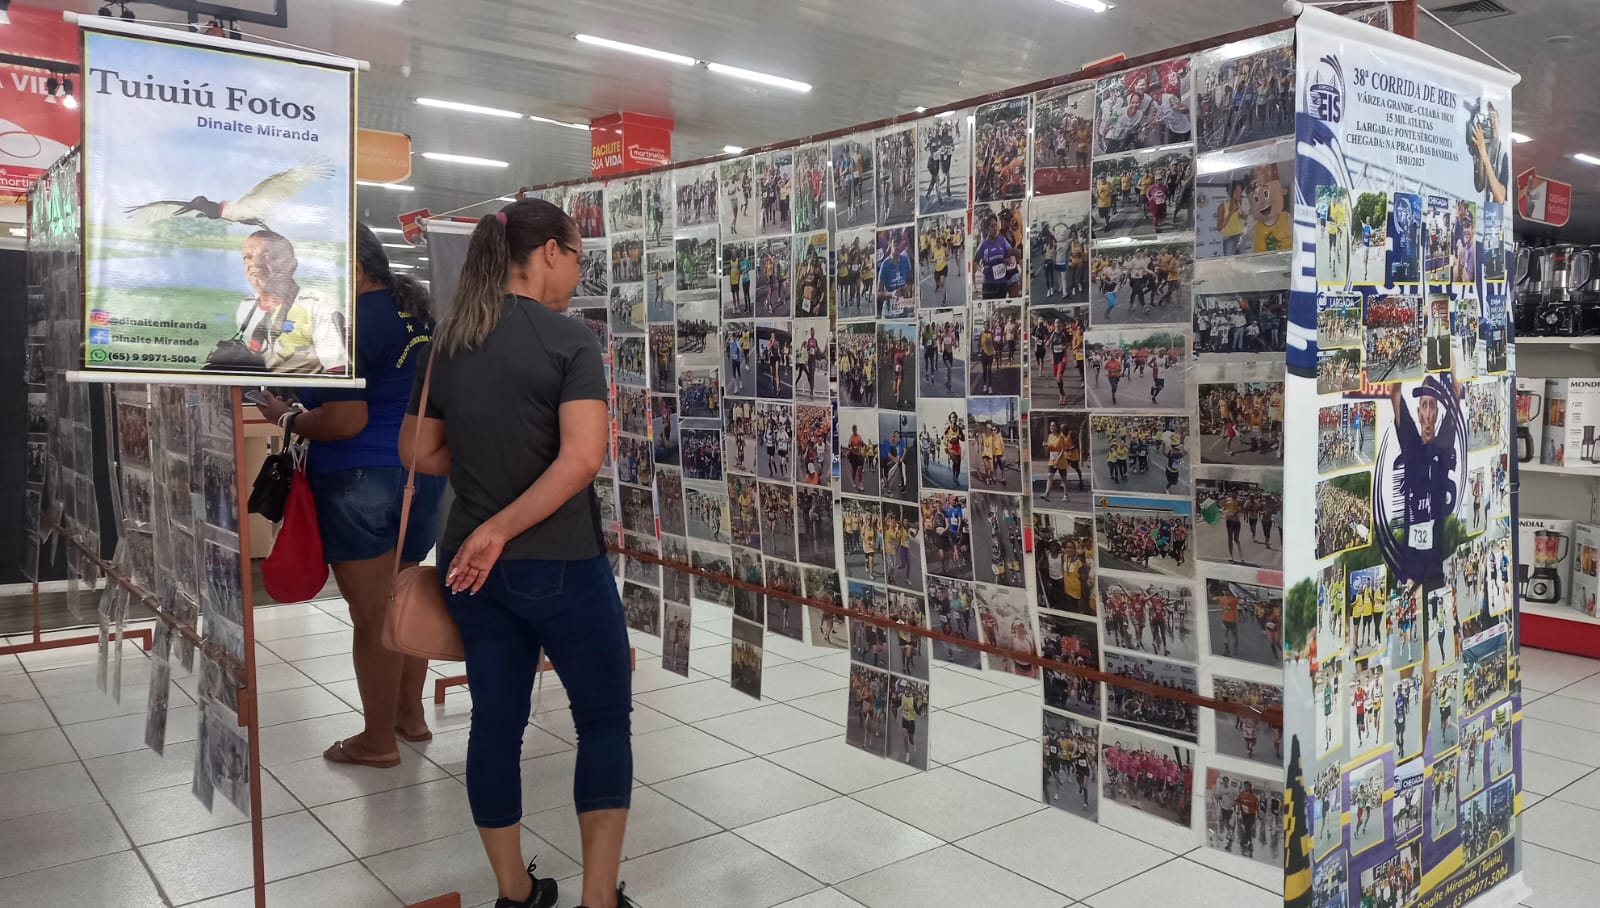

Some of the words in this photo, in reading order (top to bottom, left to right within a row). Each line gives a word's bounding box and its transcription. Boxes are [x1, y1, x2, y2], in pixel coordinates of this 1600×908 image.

[89, 67, 216, 109] Tuiuiú
[225, 86, 316, 122] Fotos
[1371, 71, 1421, 100] CORRIDA
[1423, 84, 1436, 104] DE
[1438, 88, 1457, 110] REIS
[1357, 90, 1386, 109] VÁRZEA
[197, 116, 253, 134] Dinalte
[257, 124, 319, 142] Miranda
[1386, 112, 1394, 123] 15
[1394, 113, 1407, 126] MIL
[1407, 117, 1434, 131] ATLETAS
[1394, 127, 1416, 141] PONTE
[592, 141, 621, 157] FACILITE
[1386, 140, 1396, 150] NA
[1396, 141, 1419, 154] PRAÇA
[1419, 145, 1431, 156] DAS
[591, 156, 604, 171] SUA
[605, 154, 622, 168] VIDA
[154, 336, 199, 346] Miranda
[108, 351, 130, 362] (65)
[132, 353, 139, 361] 9
[141, 353, 197, 363] 9971-5004
[1413, 528, 1428, 544] 732
[1444, 867, 1477, 897] Miranda
